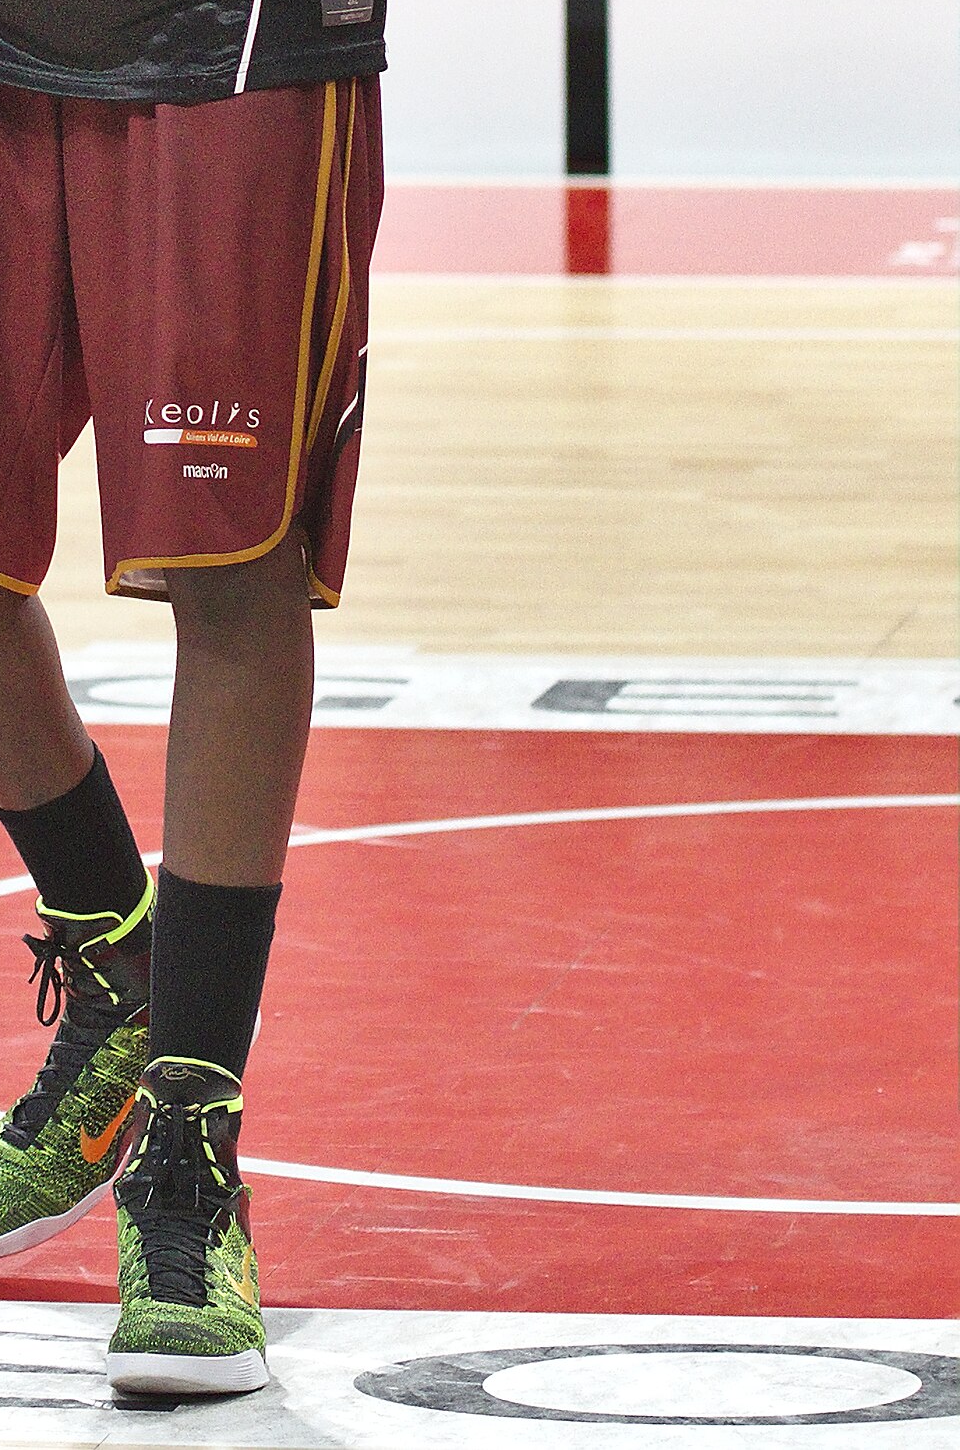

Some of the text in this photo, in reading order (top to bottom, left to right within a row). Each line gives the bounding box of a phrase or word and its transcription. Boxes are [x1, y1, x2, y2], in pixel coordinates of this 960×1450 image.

[219, 434, 229, 443] de
[229, 435, 251, 445] Loire
[183, 463, 228, 479] macron
